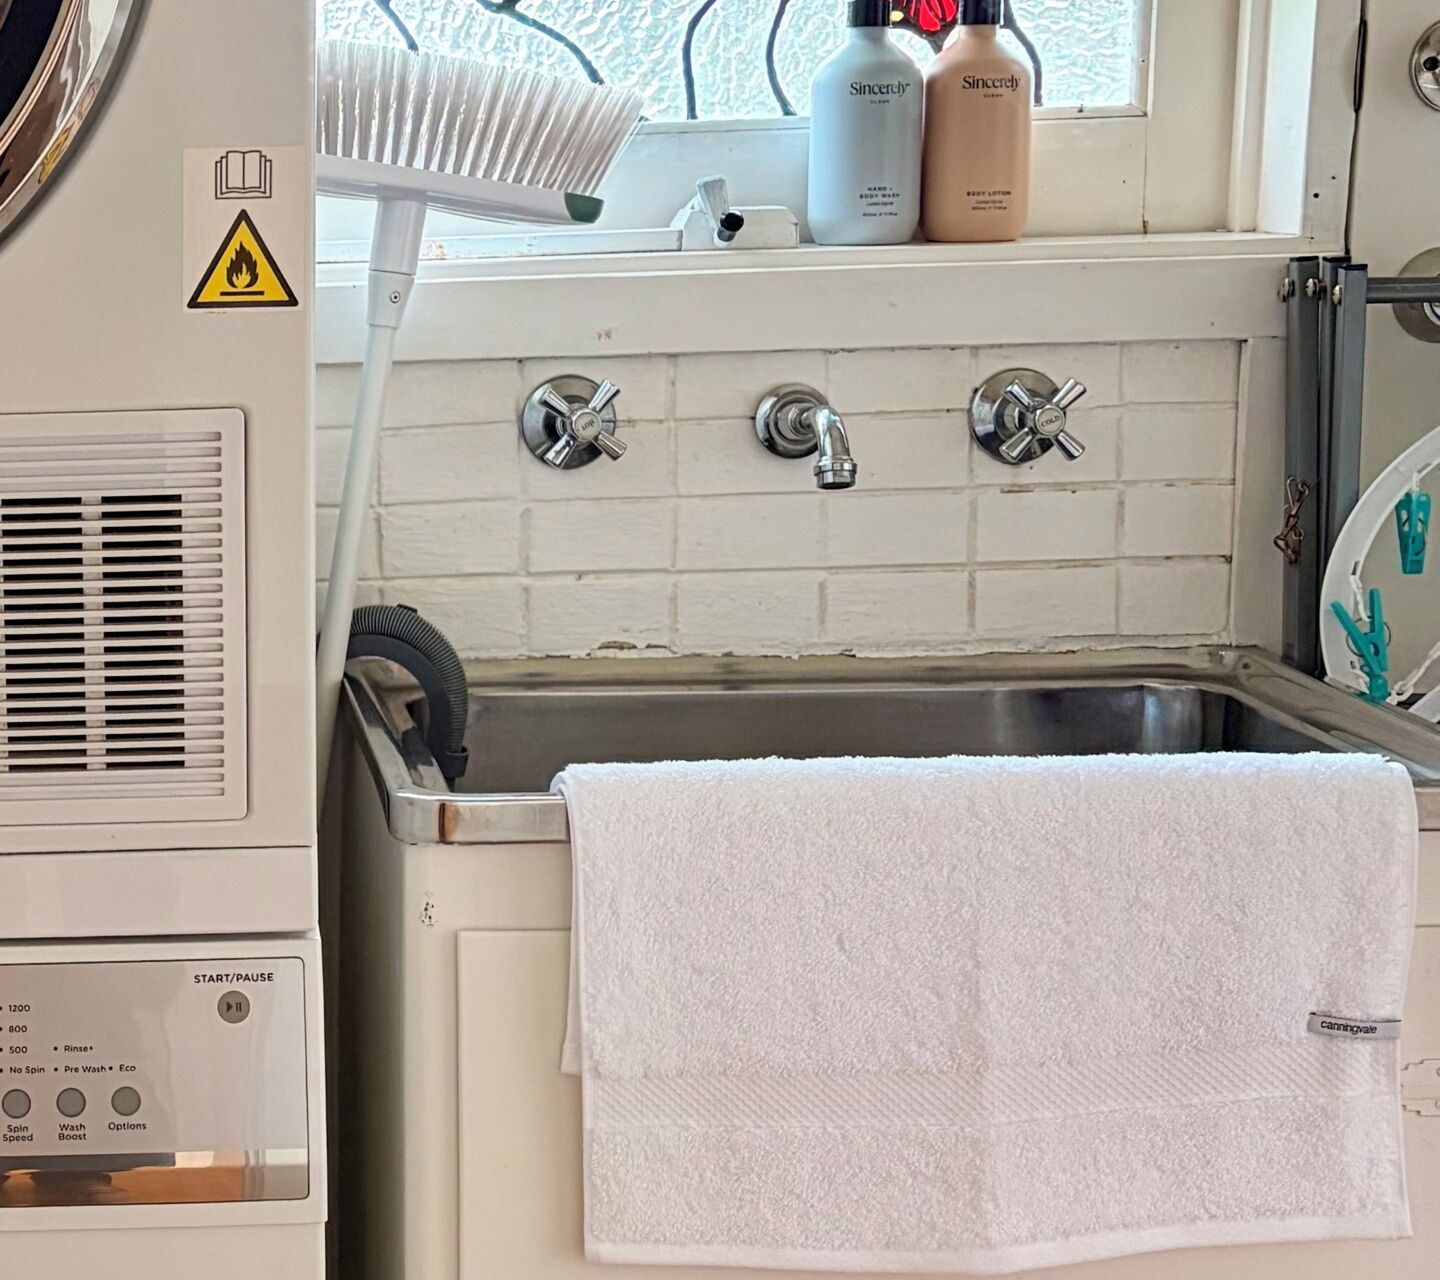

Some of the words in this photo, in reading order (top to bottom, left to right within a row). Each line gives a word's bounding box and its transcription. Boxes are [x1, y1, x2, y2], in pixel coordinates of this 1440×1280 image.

[962, 74, 1021, 92] Sincerely
[1041, 415, 1061, 427] COLD
[194, 973, 274, 983] START/PAUSE
[8, 1004, 31, 1013] 1200
[8, 1025, 27, 1033] 800
[1320, 1020, 1377, 1035] canningvale
[9, 1046, 28, 1054] 500
[10, 1066, 22, 1074] No
[25, 1065, 45, 1075] Spin
[82, 1065, 106, 1073] Wash
[119, 1064, 136, 1072] Eco
[7, 1124, 28, 1134] Spin
[59, 1123, 85, 1131] Wash
[108, 1122, 147, 1131] Options
[3, 1133, 33, 1142] Speed
